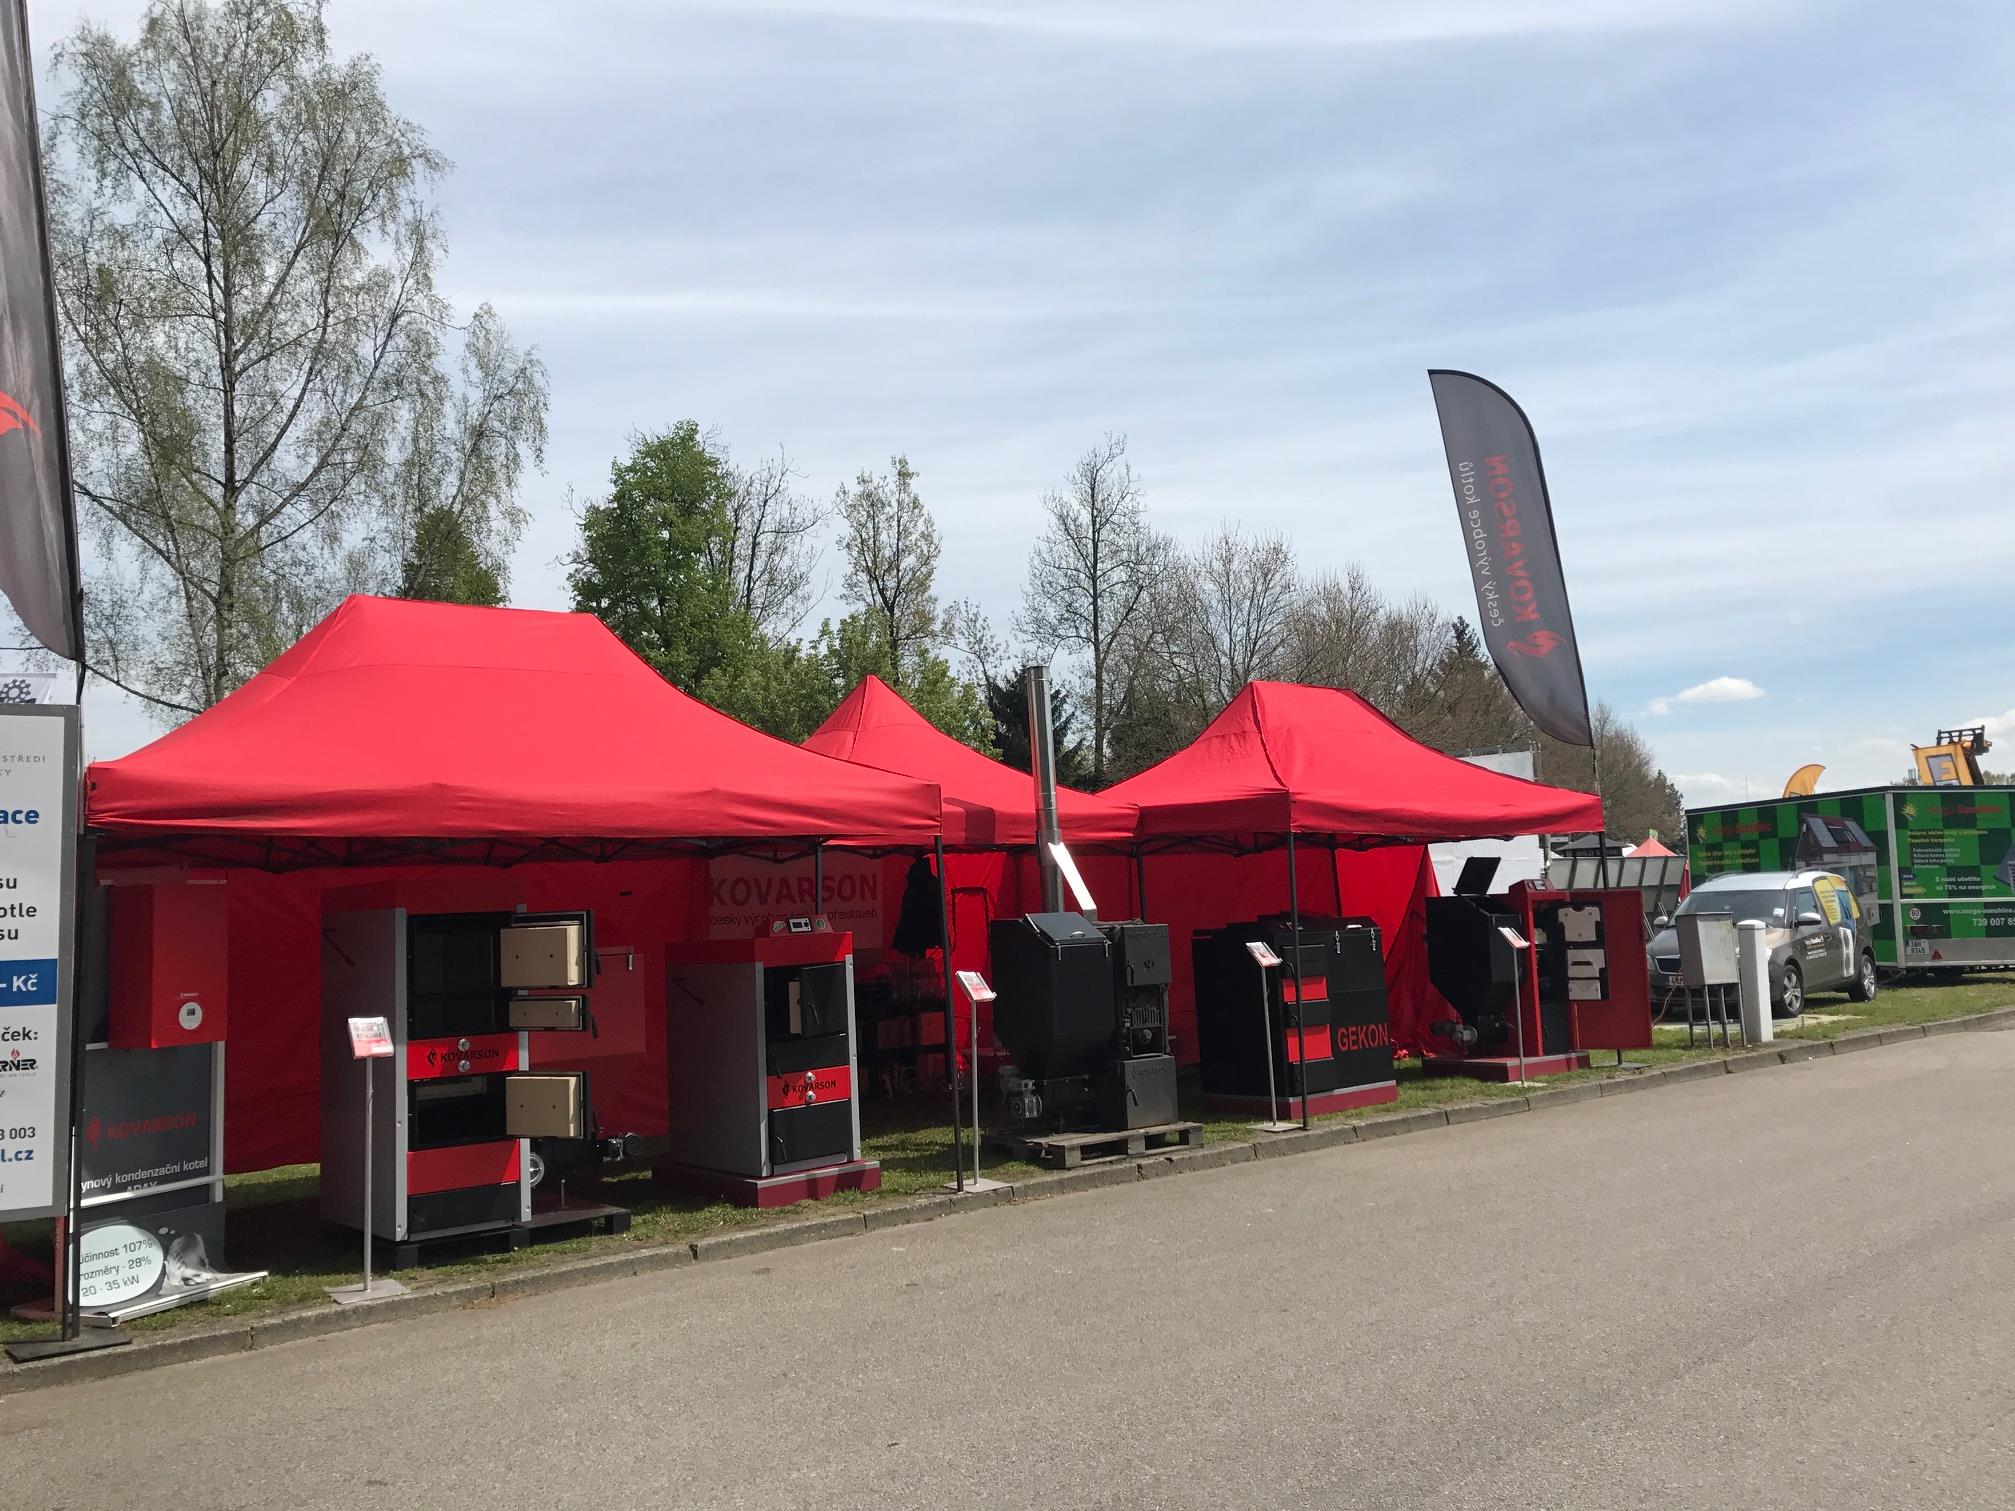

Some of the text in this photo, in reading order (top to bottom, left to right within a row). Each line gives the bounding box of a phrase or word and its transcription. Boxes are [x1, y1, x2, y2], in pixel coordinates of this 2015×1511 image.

[0, 809, 39, 824] ace
[710, 873, 878, 907] KOVARSON
[1990, 918, 2004, 926] 007
[12, 974, 38, 992] Kč
[1, 1027, 38, 1041] ček:
[1337, 1023, 1389, 1052] GEKON
[441, 1049, 500, 1063] KOVARSON
[792, 1080, 837, 1094] KOVARSON
[9, 1127, 36, 1139] 003
[1, 1149, 34, 1162] l.cz
[115, 1161, 181, 1184] kondenzační
[183, 1157, 208, 1172] kotel
[122, 1240, 153, 1255] 107%
[128, 1256, 152, 1269] 28%
[81, 1285, 97, 1297] 20
[105, 1280, 120, 1291] 35
[122, 1275, 140, 1287] kW
